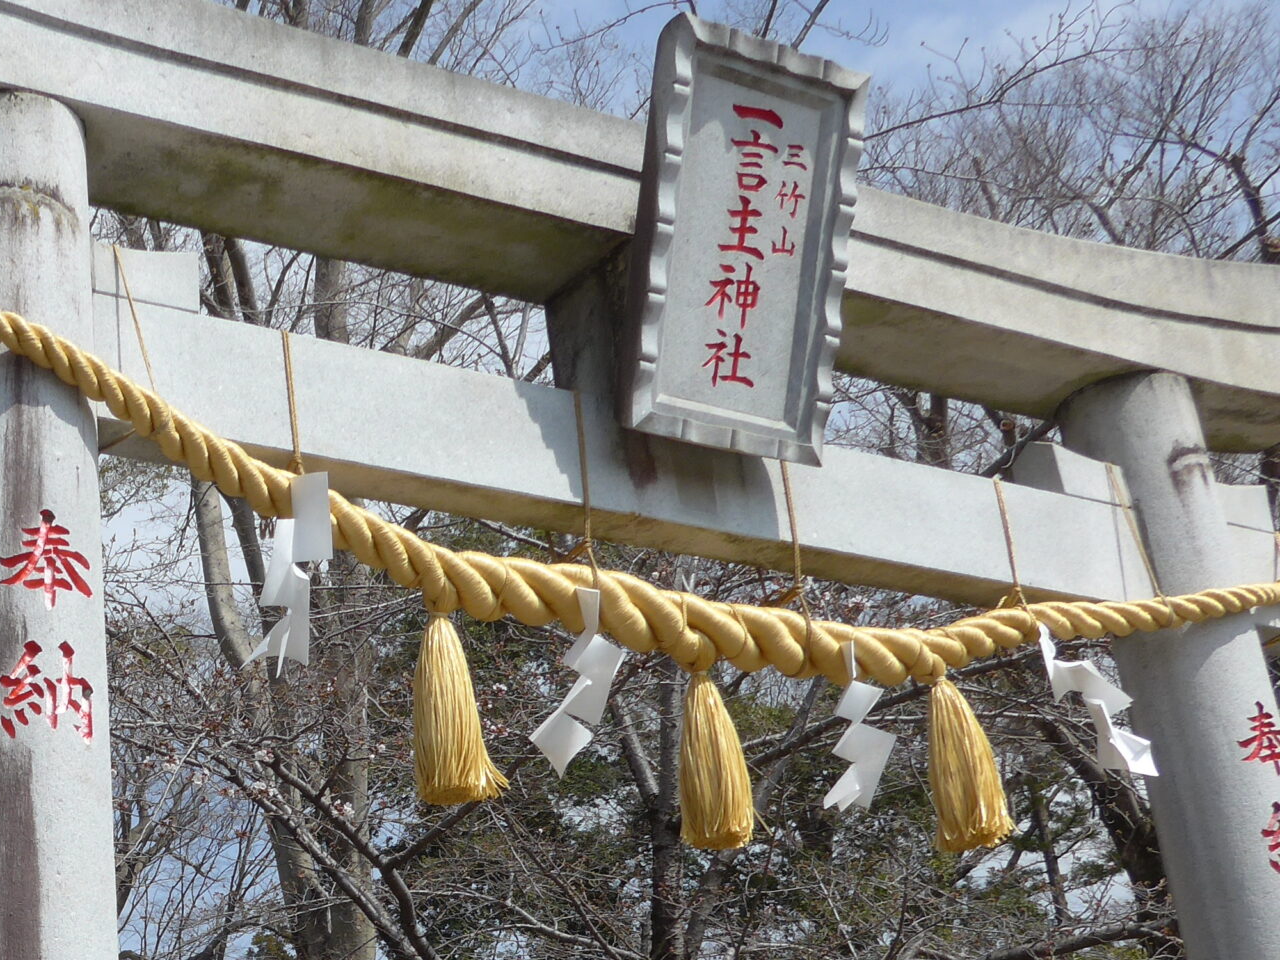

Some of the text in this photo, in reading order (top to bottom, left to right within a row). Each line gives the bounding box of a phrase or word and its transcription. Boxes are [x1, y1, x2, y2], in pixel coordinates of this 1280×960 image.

[701, 102, 785, 390] 一言主神社
[770, 143, 809, 259] 三竹山
